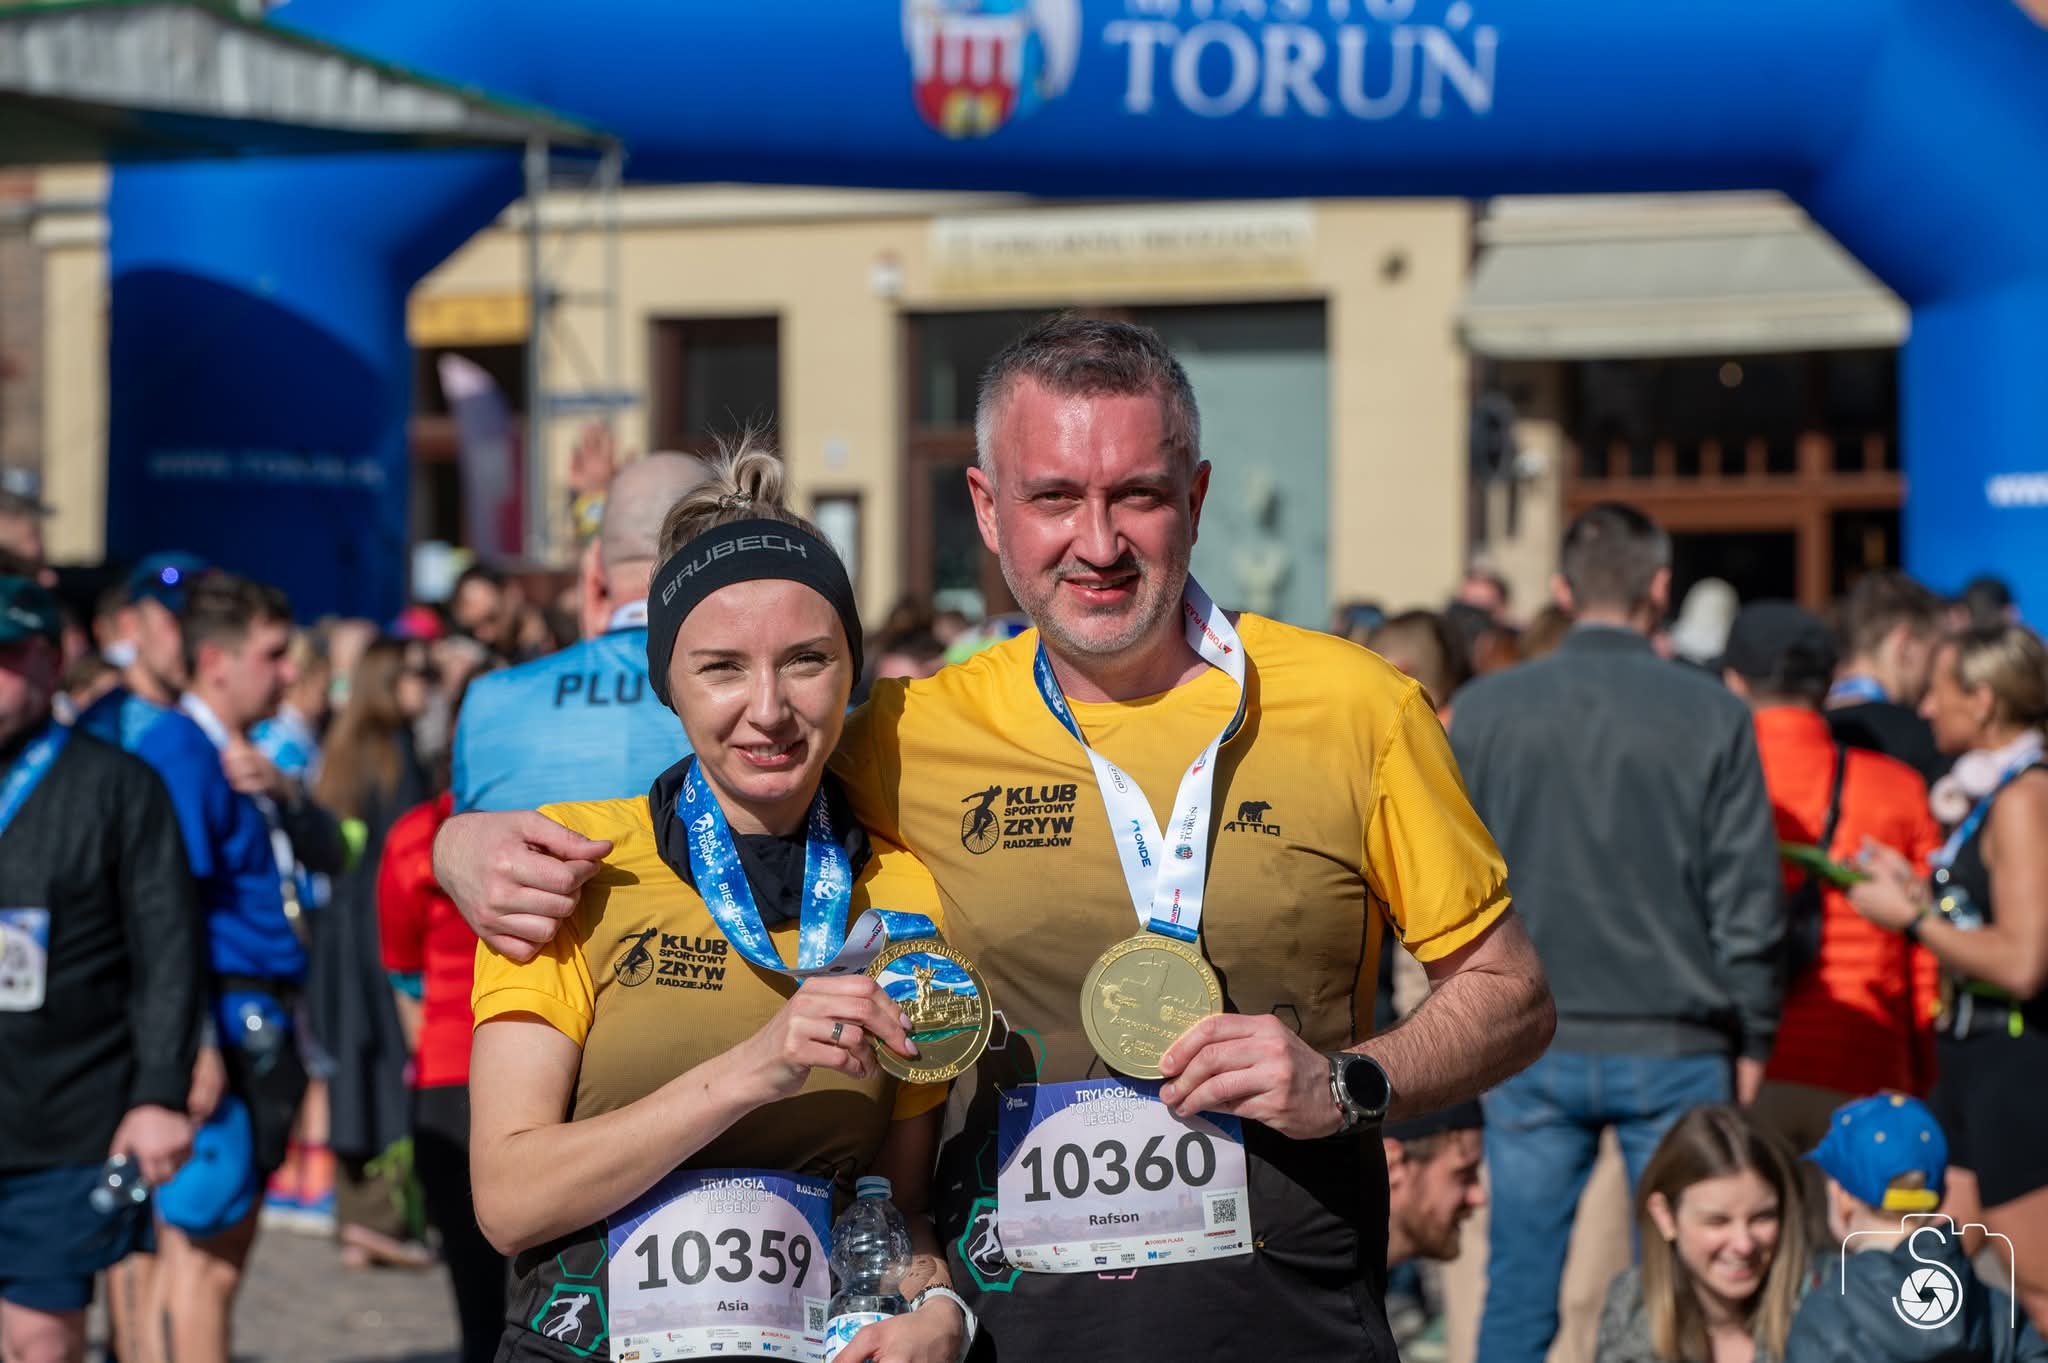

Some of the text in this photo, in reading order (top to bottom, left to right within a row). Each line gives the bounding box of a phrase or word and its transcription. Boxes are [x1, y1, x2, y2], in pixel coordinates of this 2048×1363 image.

[1103, 2, 1497, 119] TORUŃ
[1006, 784, 1077, 806] KLUB
[1004, 803, 1075, 816] SPORTOWY
[1004, 816, 1075, 836] ZRYW
[1002, 834, 1072, 849] RADZIEJÓW
[661, 933, 729, 956] KLUB
[658, 948, 727, 965] SPORTOWY
[657, 960, 726, 981] ZRYW
[655, 977, 723, 991] RADZIEJÓW
[1076, 1086, 1138, 1102] TRYLOGIA
[1084, 1111, 1133, 1126] LEGEND
[1021, 1131, 1216, 1203] 10360
[700, 1178, 766, 1190] TRYLOGIA
[708, 1201, 760, 1214] LEGEND
[1089, 1211, 1140, 1226] Rafson
[634, 1228, 812, 1290] 10359
[717, 1300, 749, 1312] Asia
